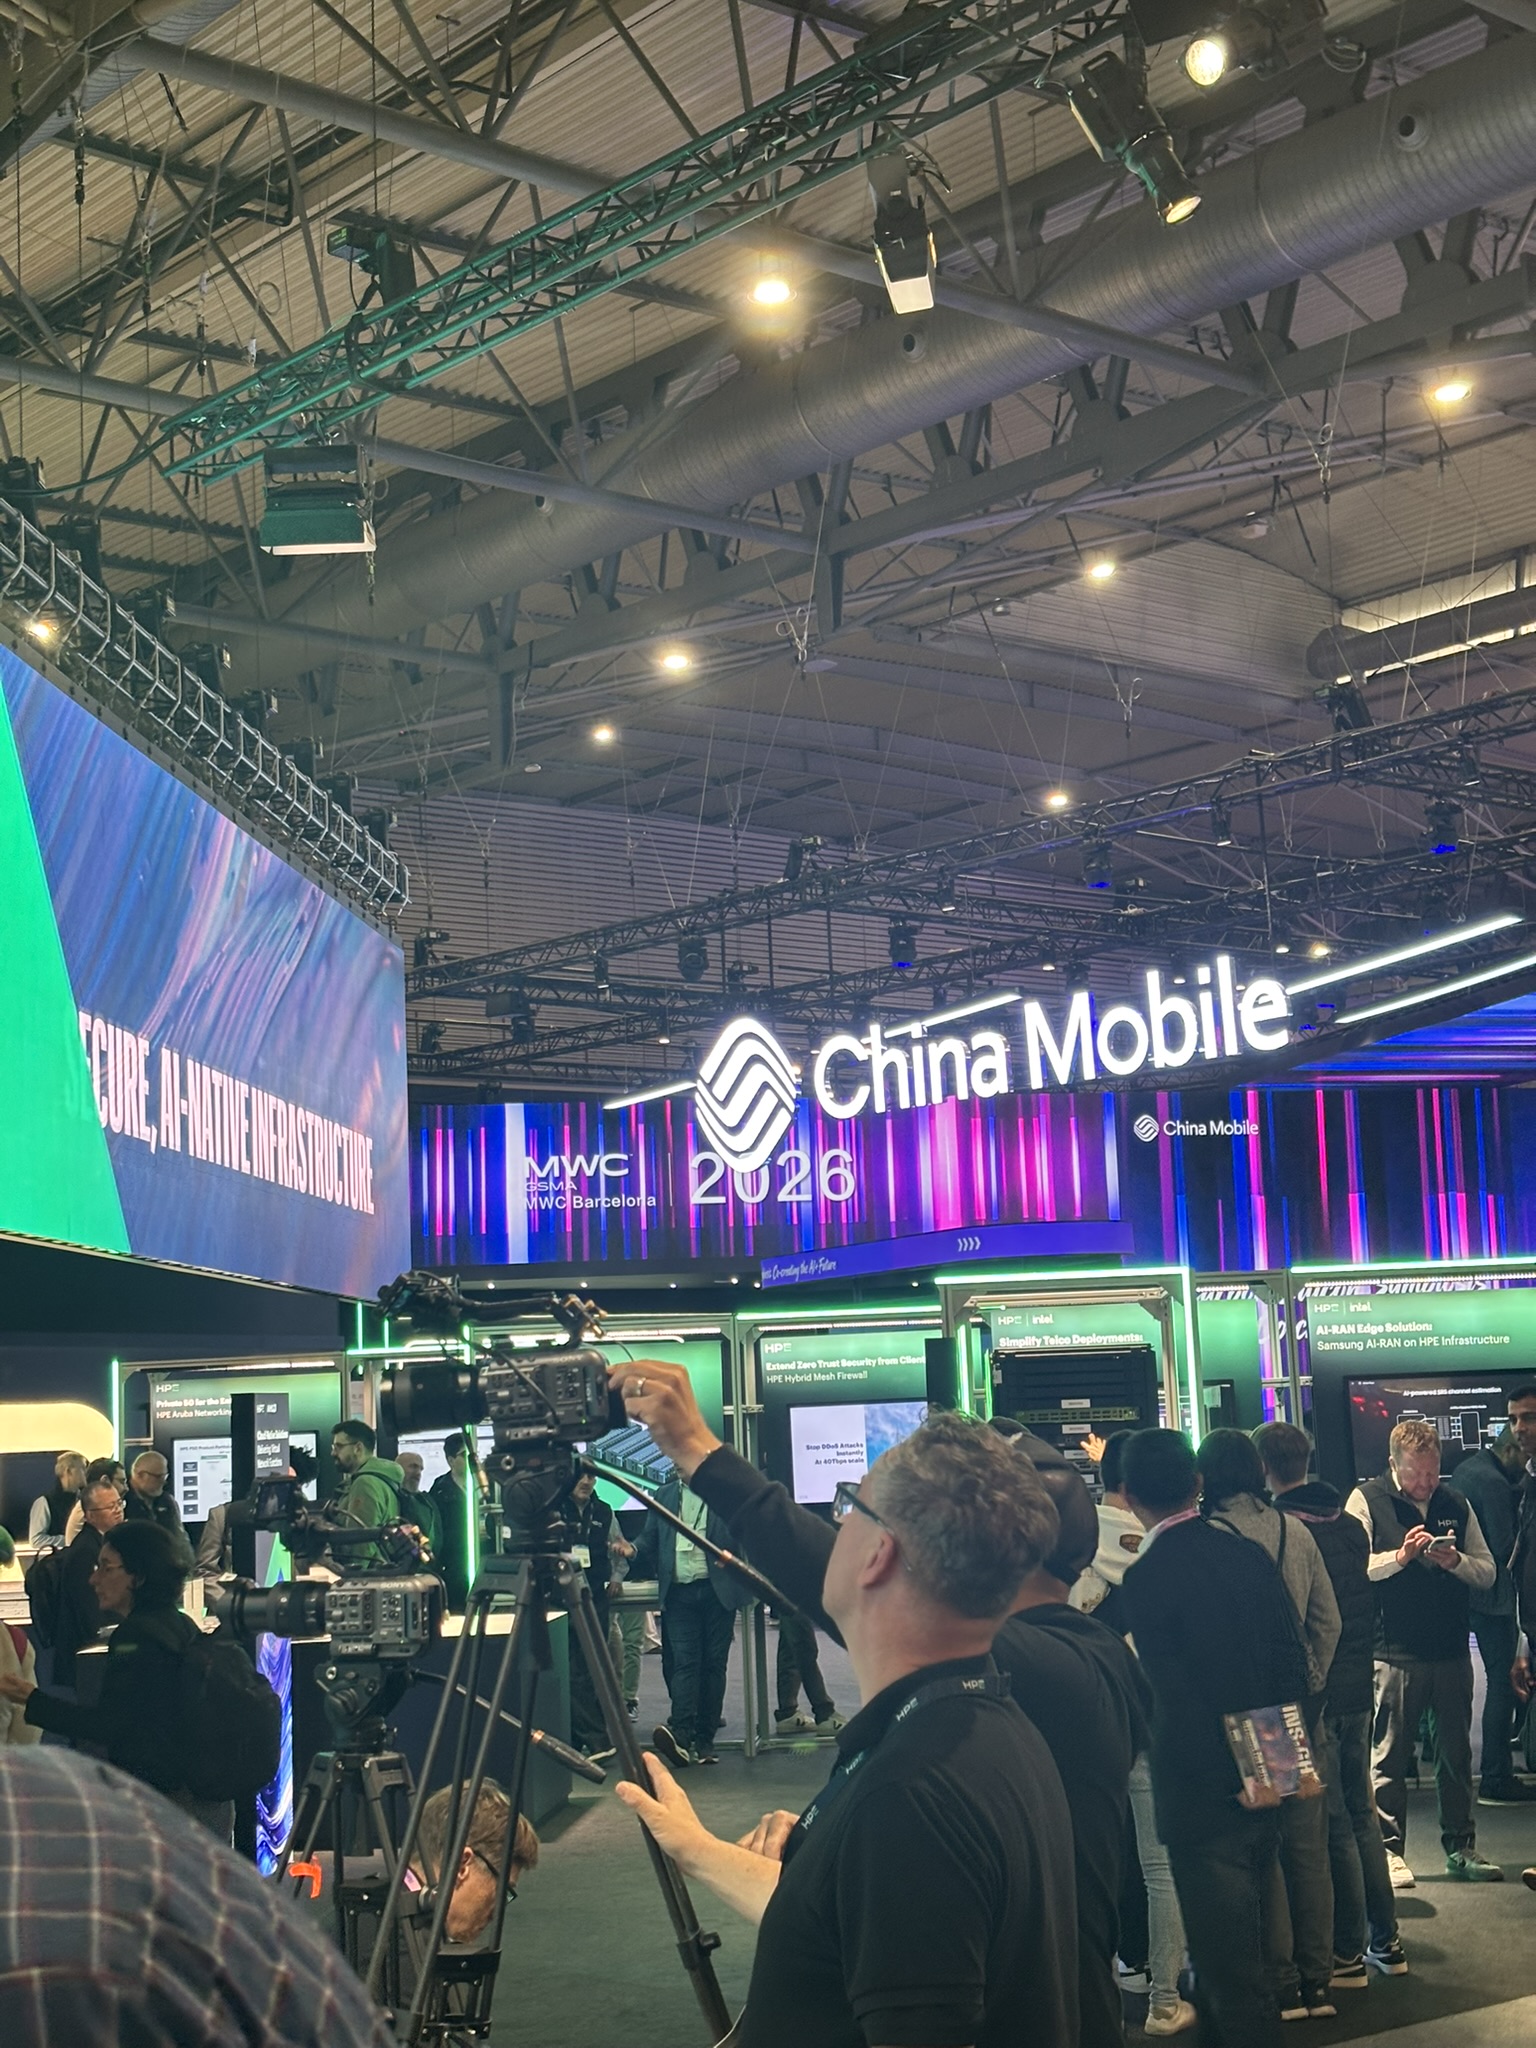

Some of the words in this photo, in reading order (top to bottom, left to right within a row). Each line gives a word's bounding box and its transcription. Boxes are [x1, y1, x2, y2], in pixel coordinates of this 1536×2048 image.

[813, 1023, 1009, 1120] China
[1024, 954, 1290, 1090] Mobile
[160, 1046, 251, 1175] AI-NATIVE
[251, 1086, 375, 1215] INFRASTRUCTURE
[1163, 1120, 1207, 1136] China
[1209, 1119, 1259, 1136] Mobile
[525, 1153, 629, 1178] MWC
[690, 1148, 856, 1205] 2026
[525, 1181, 578, 1192] GSMA
[525, 1196, 567, 1210] MWC
[573, 1193, 656, 1209] Barcelona
[1314, 1303, 1339, 1313] HPE
[998, 1315, 1022, 1325] HPE
[1316, 1324, 1356, 1335] AI-RAN
[1357, 1323, 1384, 1335] Edge
[999, 1336, 1042, 1348] Simplify
[1042, 1335, 1071, 1345] Telco
[1317, 1341, 1364, 1351] Samsung
[1366, 1338, 1401, 1349] AI-RAN
[1403, 1339, 1417, 1348] on
[1419, 1336, 1440, 1347] HPE
[1441, 1334, 1510, 1346] Infrastructure
[764, 1342, 792, 1354] HPE
[765, 1361, 796, 1371] Extend
[796, 1360, 817, 1370] Zero
[817, 1359, 840, 1369] Trust
[841, 1356, 877, 1368] Security
[877, 1356, 898, 1366] from
[766, 1374, 784, 1384] HPE
[784, 1372, 812, 1385] Hybrid
[813, 1371, 836, 1381] Mesh
[837, 1370, 868, 1381] Firewall
[156, 1384, 179, 1393] HPE
[1471, 1386, 1502, 1394] estimation
[156, 1399, 183, 1408] Private
[195, 1398, 206, 1406] for
[206, 1397, 219, 1406] the
[156, 1410, 171, 1419] HPE
[172, 1409, 193, 1418] Aruba
[823, 1458, 847, 1466] 40Tbps
[1437, 1519, 1458, 1527] HPE
[962, 1679, 985, 1691] HPE
[896, 1697, 919, 1722] HPE
[801, 1804, 820, 1830] HPE
